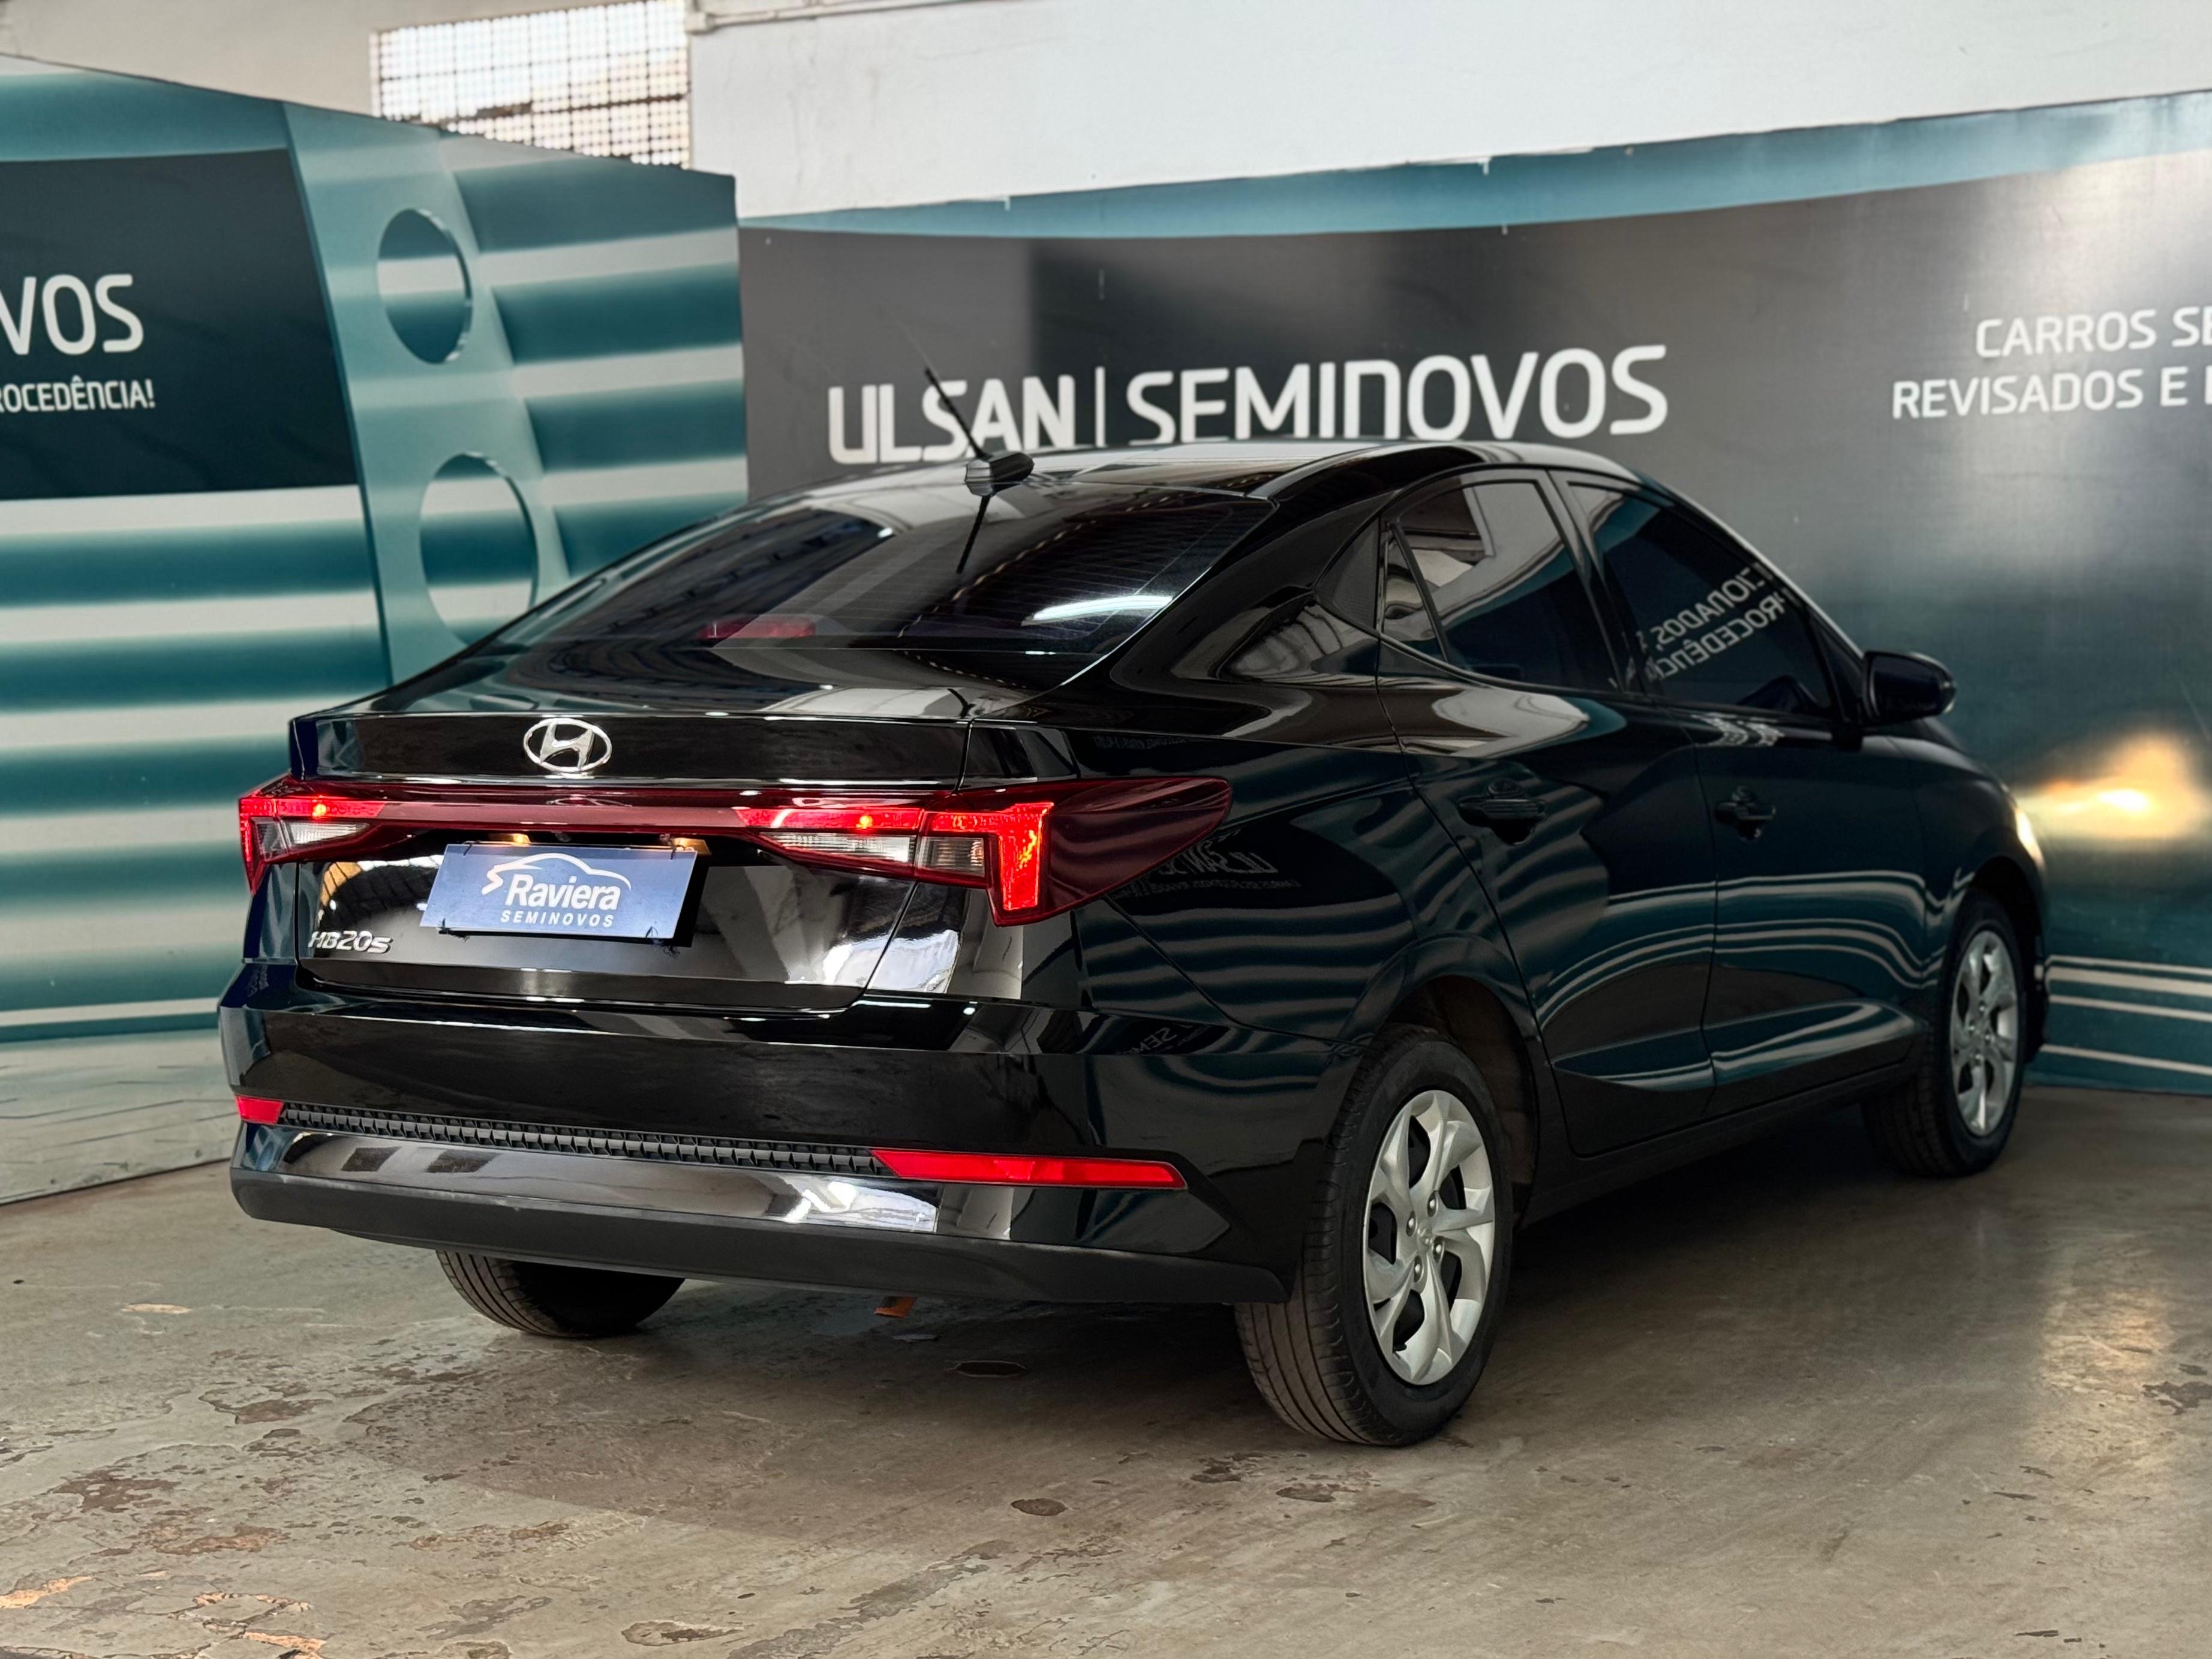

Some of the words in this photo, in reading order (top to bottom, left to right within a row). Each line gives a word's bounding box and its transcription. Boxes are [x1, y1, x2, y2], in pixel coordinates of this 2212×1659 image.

[1976, 309, 2156, 358] CARROS
[829, 374, 1075, 464] ULSAN
[1126, 344, 1668, 444] SEMINOVOS
[1893, 368, 2144, 419] REVISADOS
[2160, 366, 2188, 407] E
[506, 874, 620, 910] Raviera
[500, 910, 614, 928] SEMINOVOS
